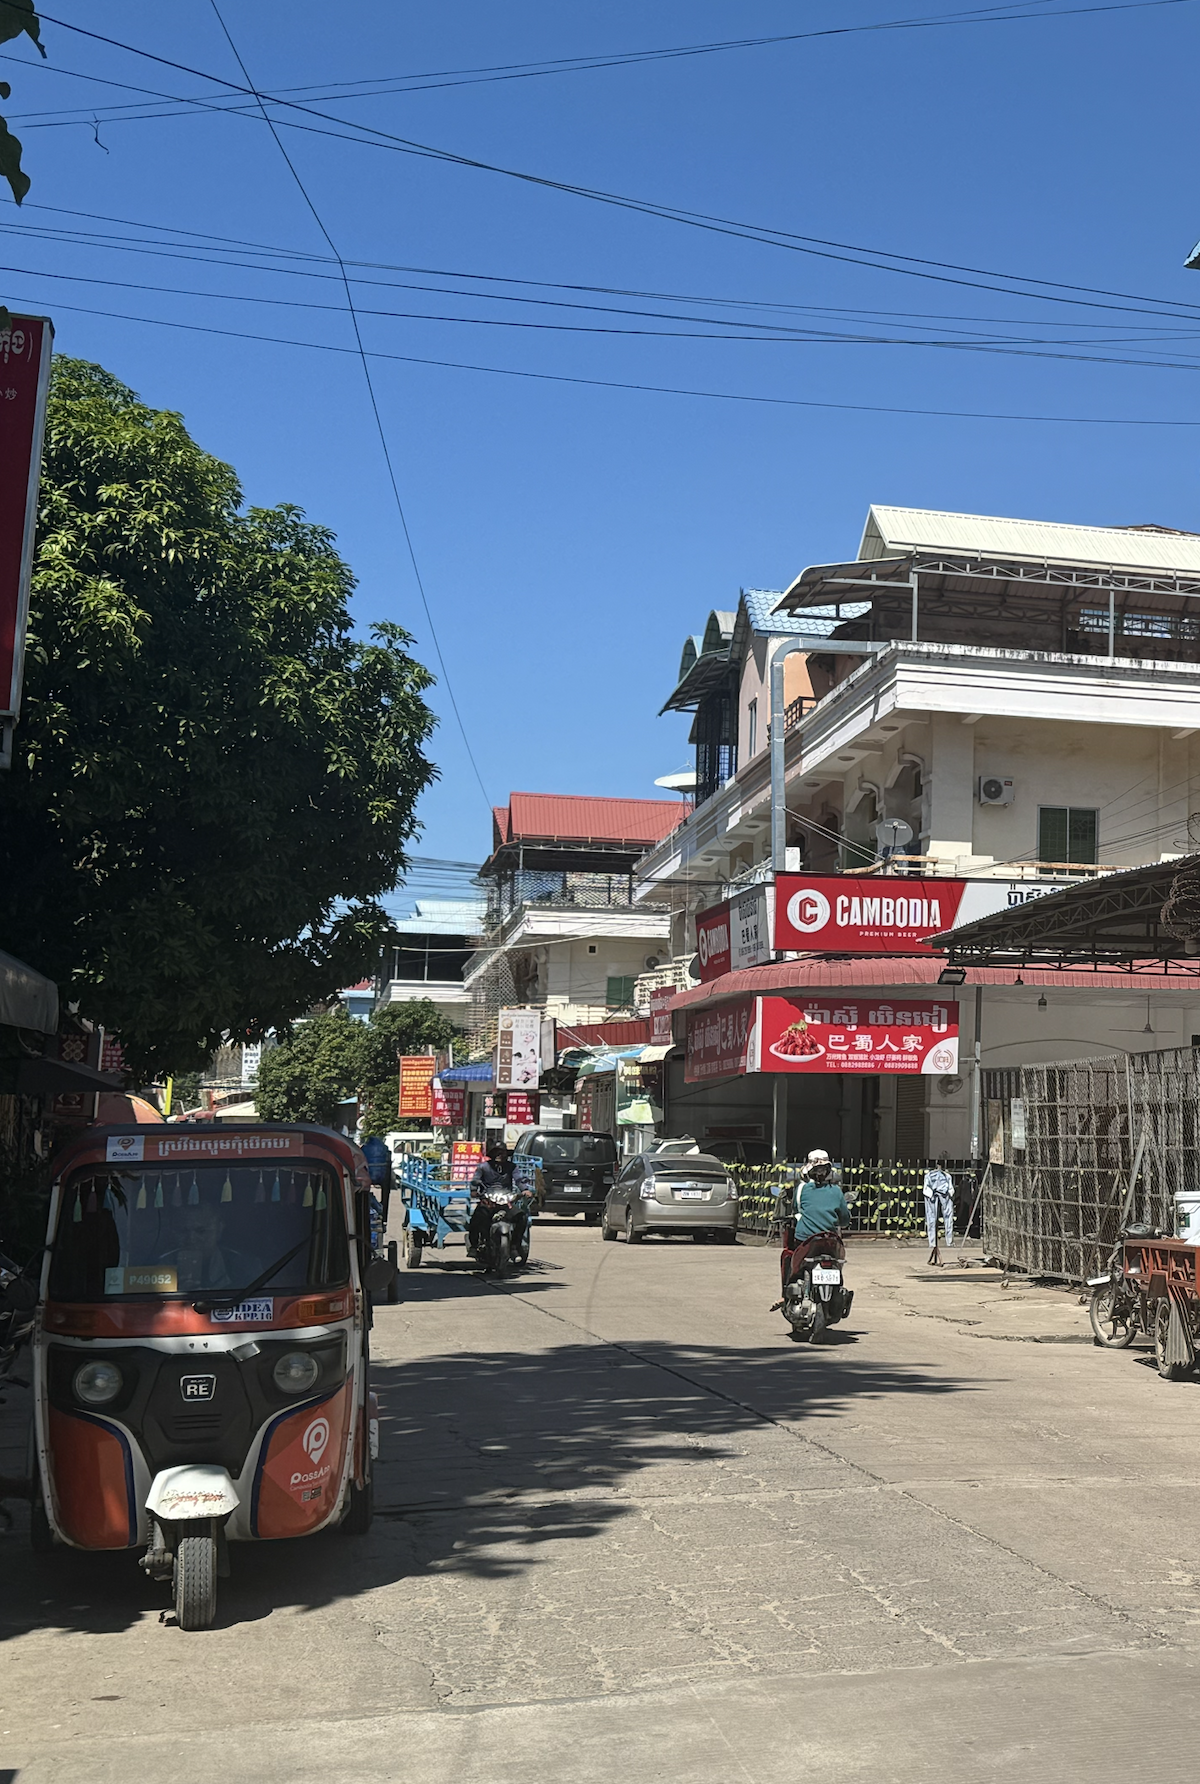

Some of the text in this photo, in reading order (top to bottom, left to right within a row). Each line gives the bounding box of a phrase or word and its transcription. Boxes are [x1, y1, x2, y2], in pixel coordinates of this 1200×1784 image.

[0, 387, 18, 400] 炒
[836, 894, 941, 928] CAMBODIA
[828, 1034, 924, 1052] 巴蜀人家
[129, 1274, 172, 1285] P49052
[186, 1383, 210, 1396] RE
